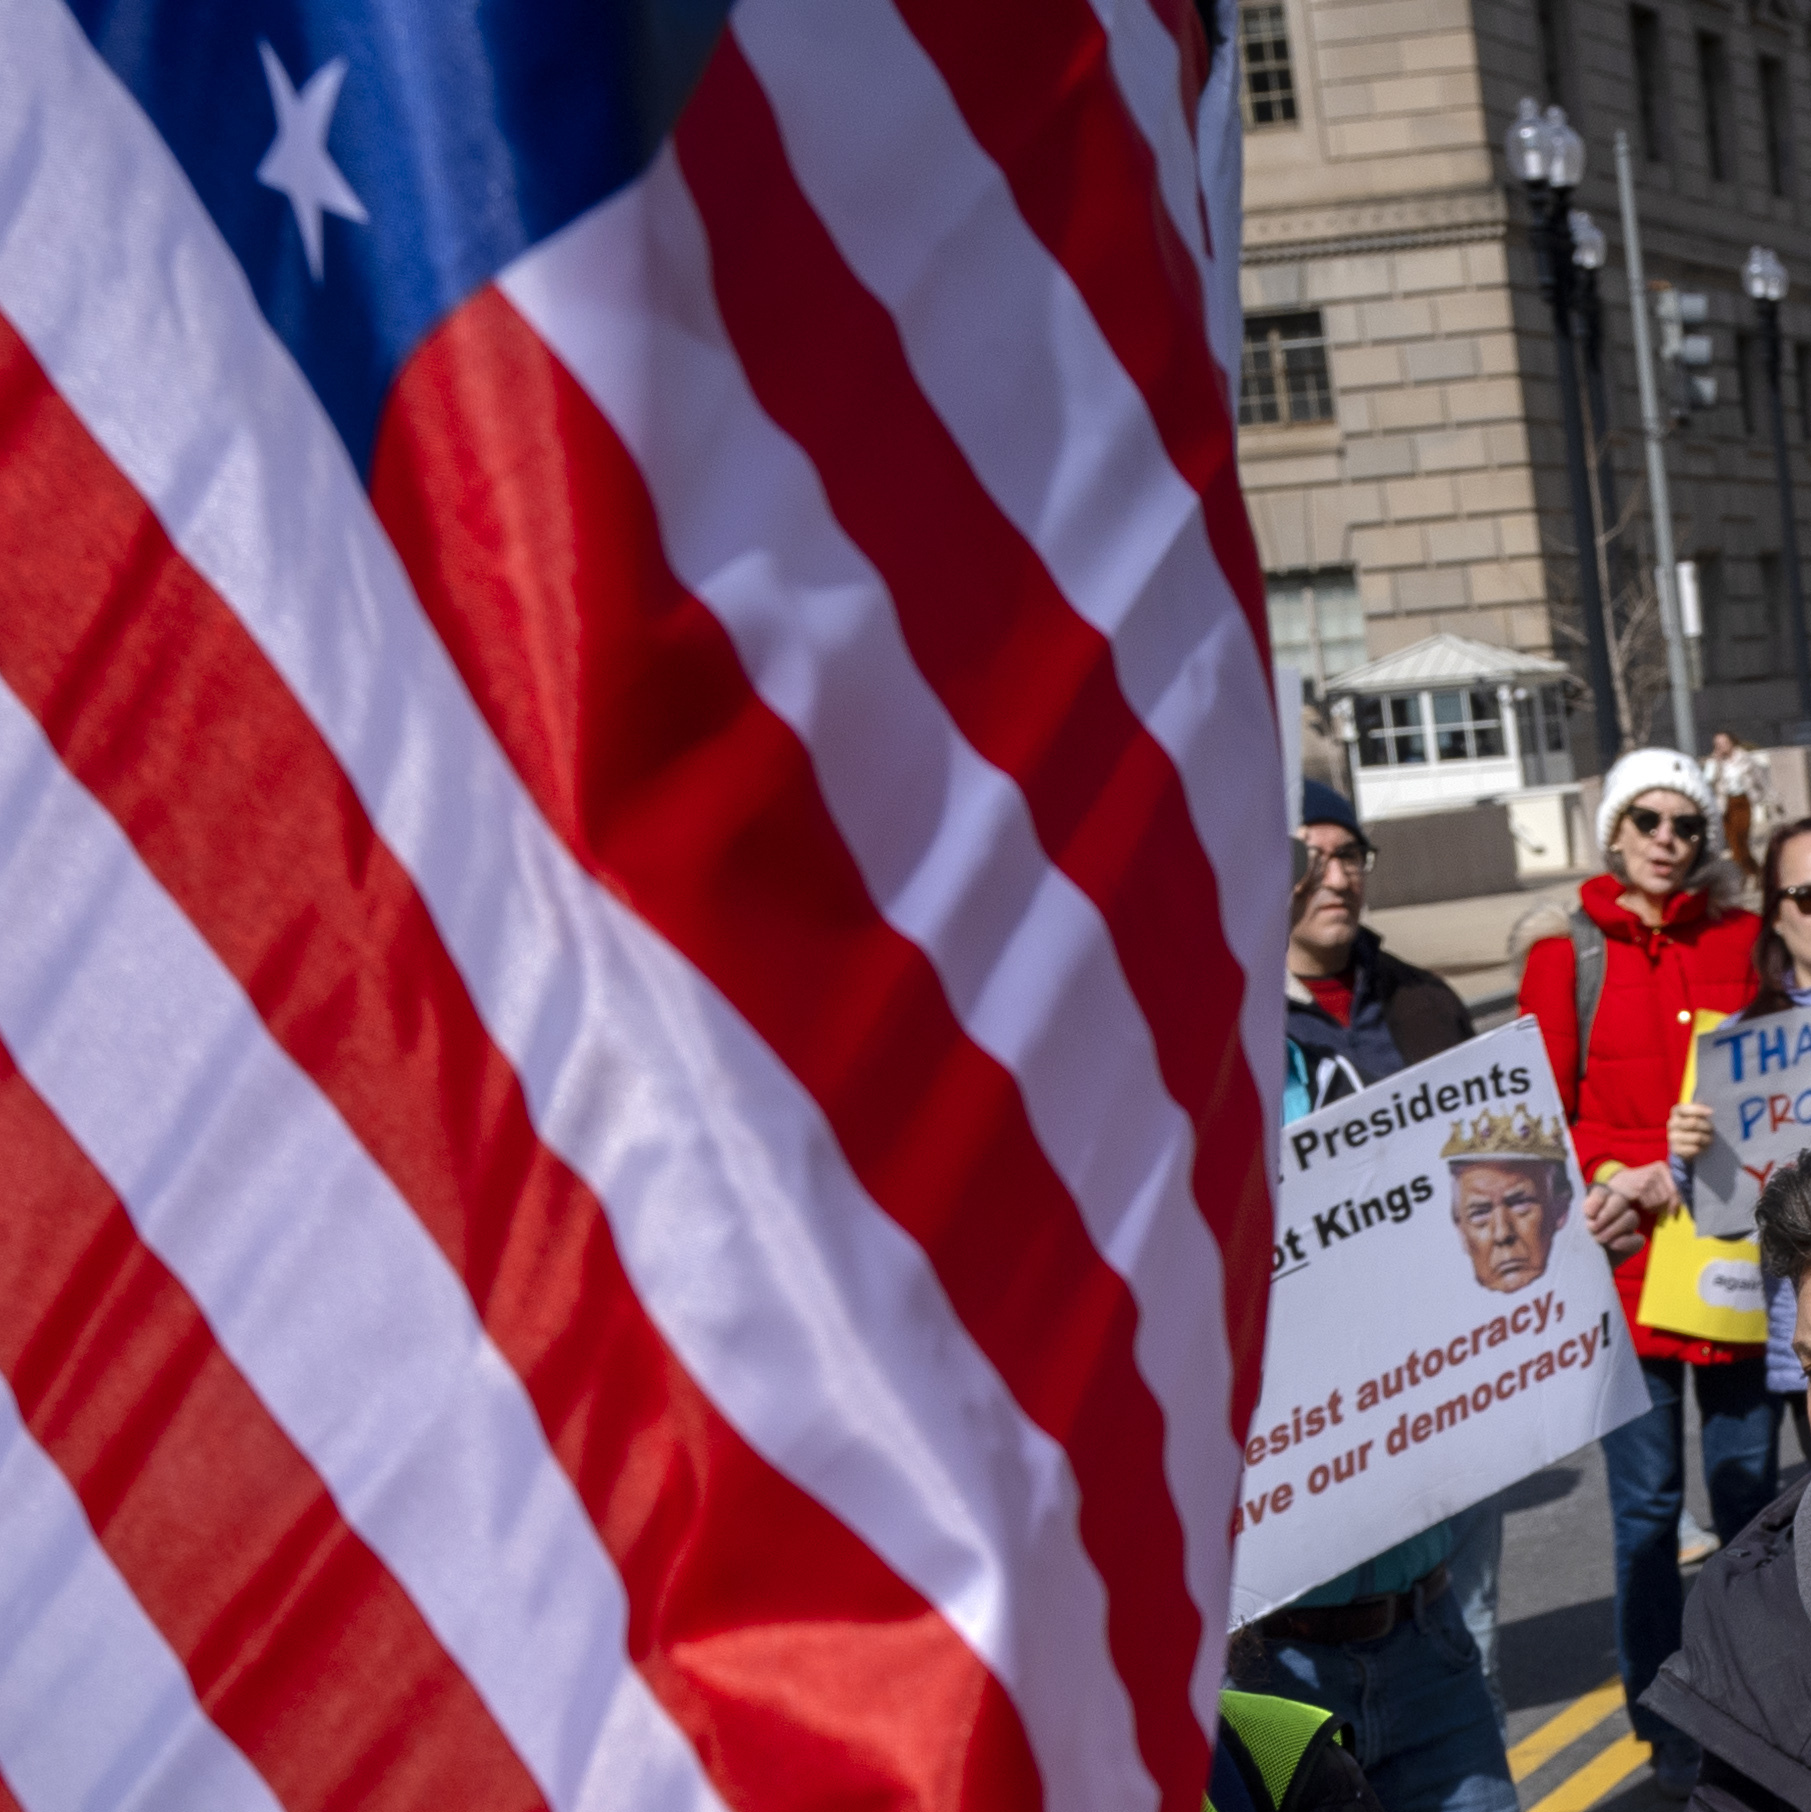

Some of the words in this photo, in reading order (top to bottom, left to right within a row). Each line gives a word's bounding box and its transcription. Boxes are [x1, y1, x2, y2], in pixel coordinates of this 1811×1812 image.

[1290, 1062, 1533, 1171] Presidents
[1312, 1172, 1434, 1251] Kings
[1307, 1438, 1375, 1497] our
[1385, 1311, 1612, 1459] democracy!
[1355, 1290, 1565, 1413] autocracy,
